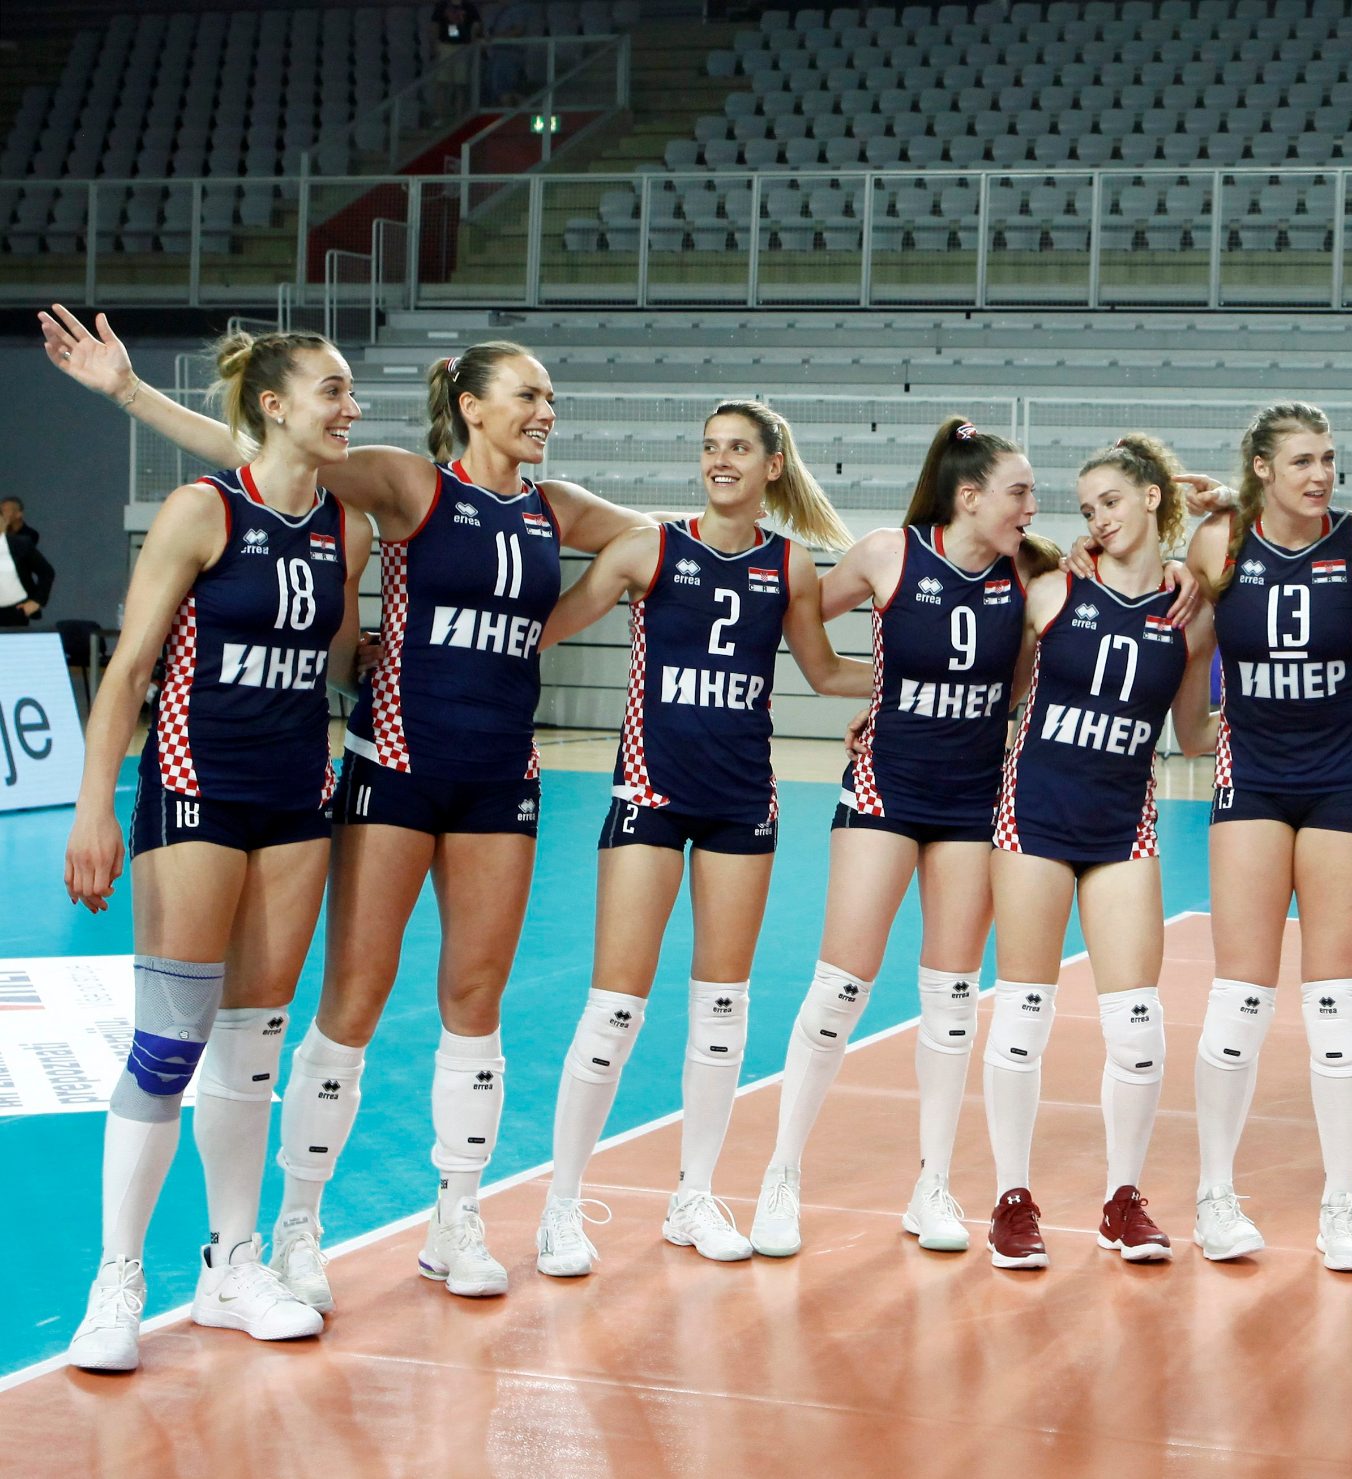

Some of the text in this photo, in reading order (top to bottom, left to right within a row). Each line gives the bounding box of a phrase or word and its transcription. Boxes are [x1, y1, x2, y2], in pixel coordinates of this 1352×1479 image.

[494, 531, 522, 599] 11
[673, 574, 701, 586] errea
[1239, 574, 1265, 586] errea
[274, 557, 316, 630] 18
[915, 592, 942, 605] errea
[476, 610, 543, 660] HEP
[708, 587, 741, 657] 2
[1071, 618, 1097, 631] errea
[1267, 584, 1310, 648] 13
[948, 605, 977, 671] 9
[1090, 633, 1139, 702] 17
[1273, 659, 1346, 700] HEP
[700, 669, 765, 711] HEP
[936, 681, 1004, 719] HEP
[1077, 710, 1152, 756] HEP
[356, 784, 372, 816] 11
[622, 804, 639, 834] 2
[712, 1006, 732, 1014] errea
[317, 1091, 339, 1100] errea
[473, 1083, 493, 1091] errea
